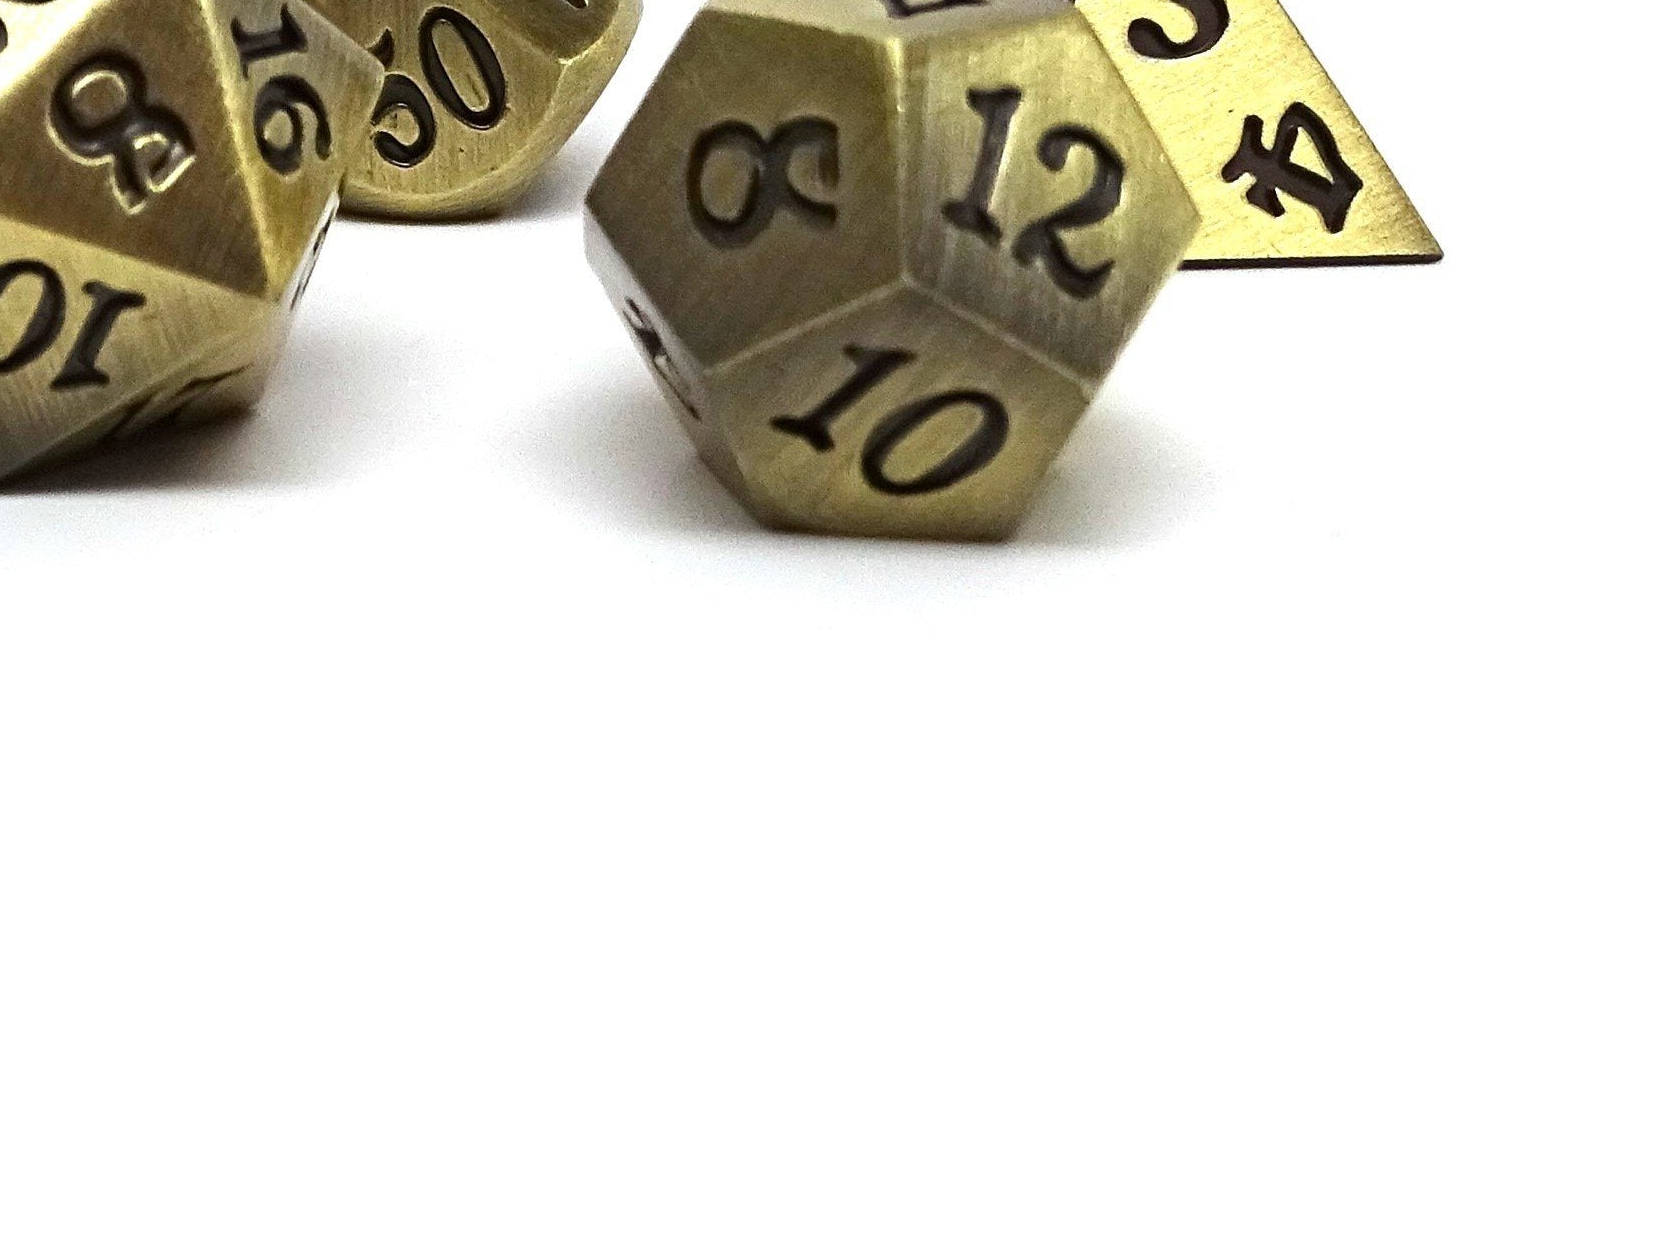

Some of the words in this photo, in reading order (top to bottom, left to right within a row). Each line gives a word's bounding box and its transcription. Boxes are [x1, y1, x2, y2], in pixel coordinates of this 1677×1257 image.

[46, 48, 197, 216] 8
[230, 3, 333, 176] 16
[1221, 100, 1364, 235] 4
[685, 114, 841, 250] 8
[941, 83, 1127, 301] 12
[769, 341, 1011, 496] 10
